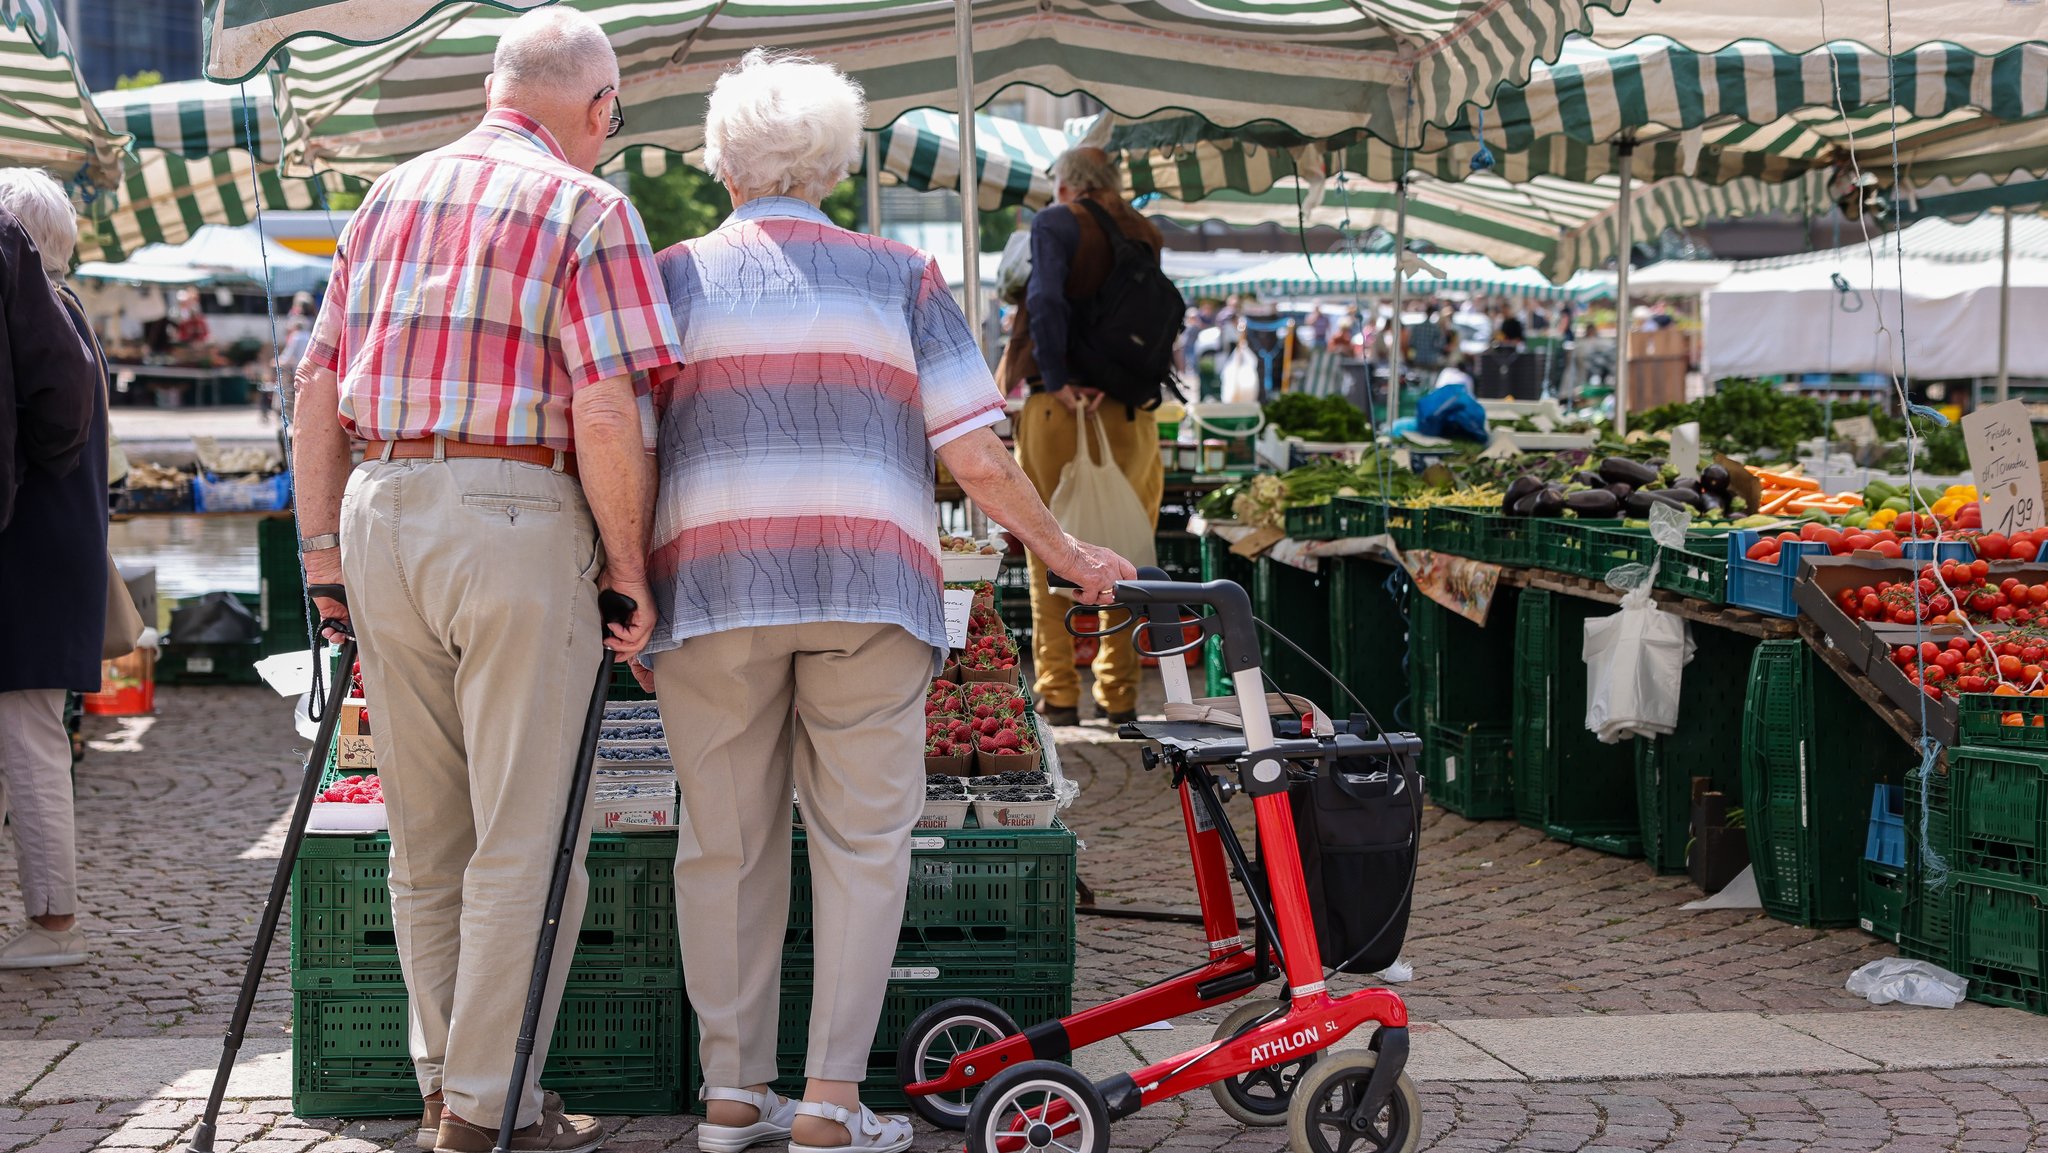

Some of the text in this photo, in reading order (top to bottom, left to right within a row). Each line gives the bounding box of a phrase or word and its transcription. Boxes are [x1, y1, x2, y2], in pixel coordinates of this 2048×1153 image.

[1984, 422, 2012, 442] Frische
[918, 820, 948, 829] FRUCHT
[1006, 818, 1036, 827] FRUCHT
[1293, 985, 1313, 995] Carbon
[1250, 1020, 1339, 1065] ATHLON SL
